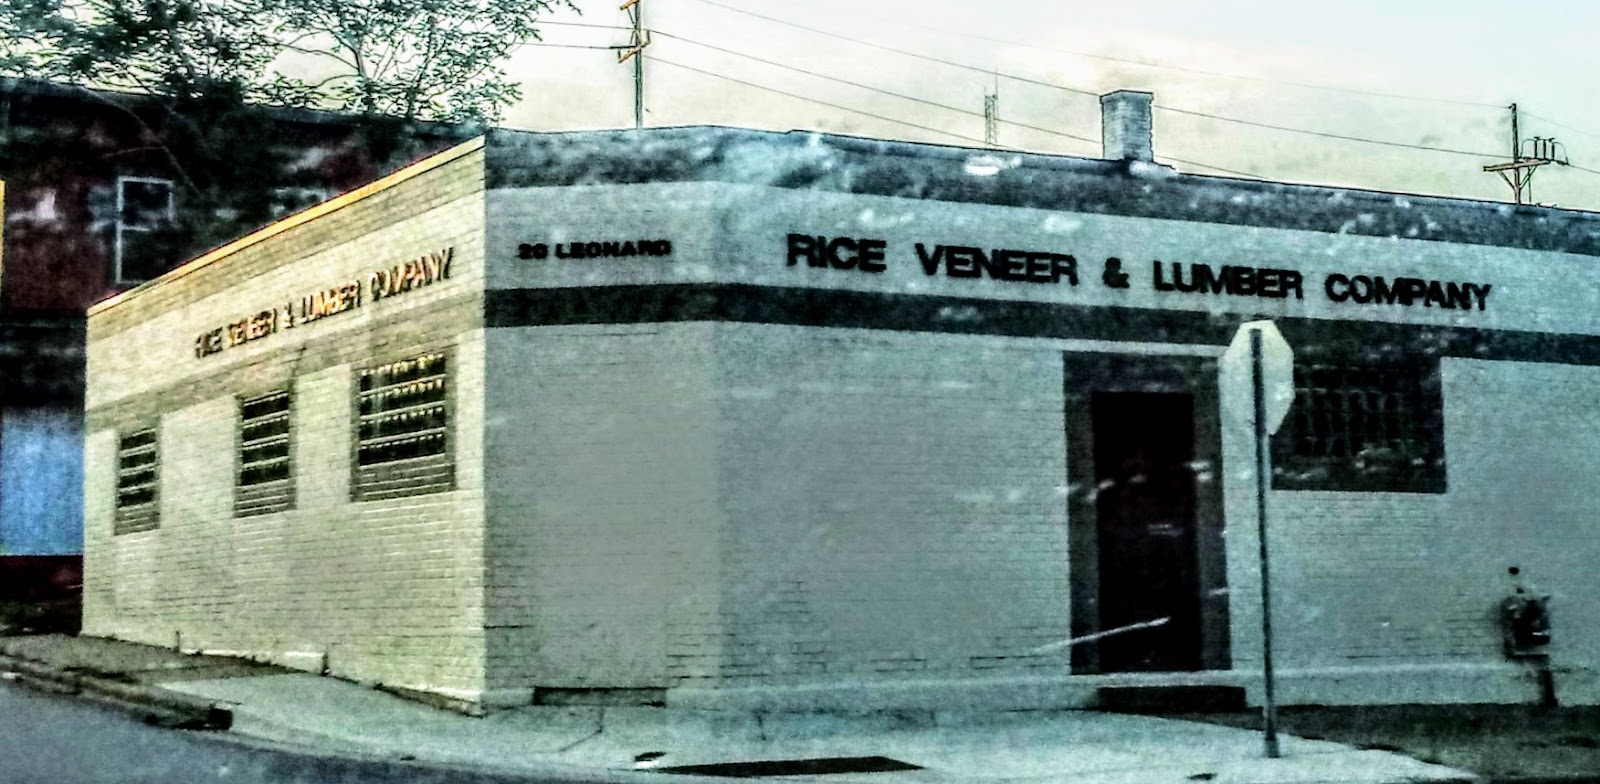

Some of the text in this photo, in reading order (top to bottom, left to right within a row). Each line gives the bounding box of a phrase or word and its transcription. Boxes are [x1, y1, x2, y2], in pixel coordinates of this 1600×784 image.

[300, 280, 362, 325] LUMBER
[366, 247, 454, 301] COMPANY
[555, 240, 672, 258] LEONARD
[786, 233, 1492, 311] RICE VENEER & LUMBER COMPANY
